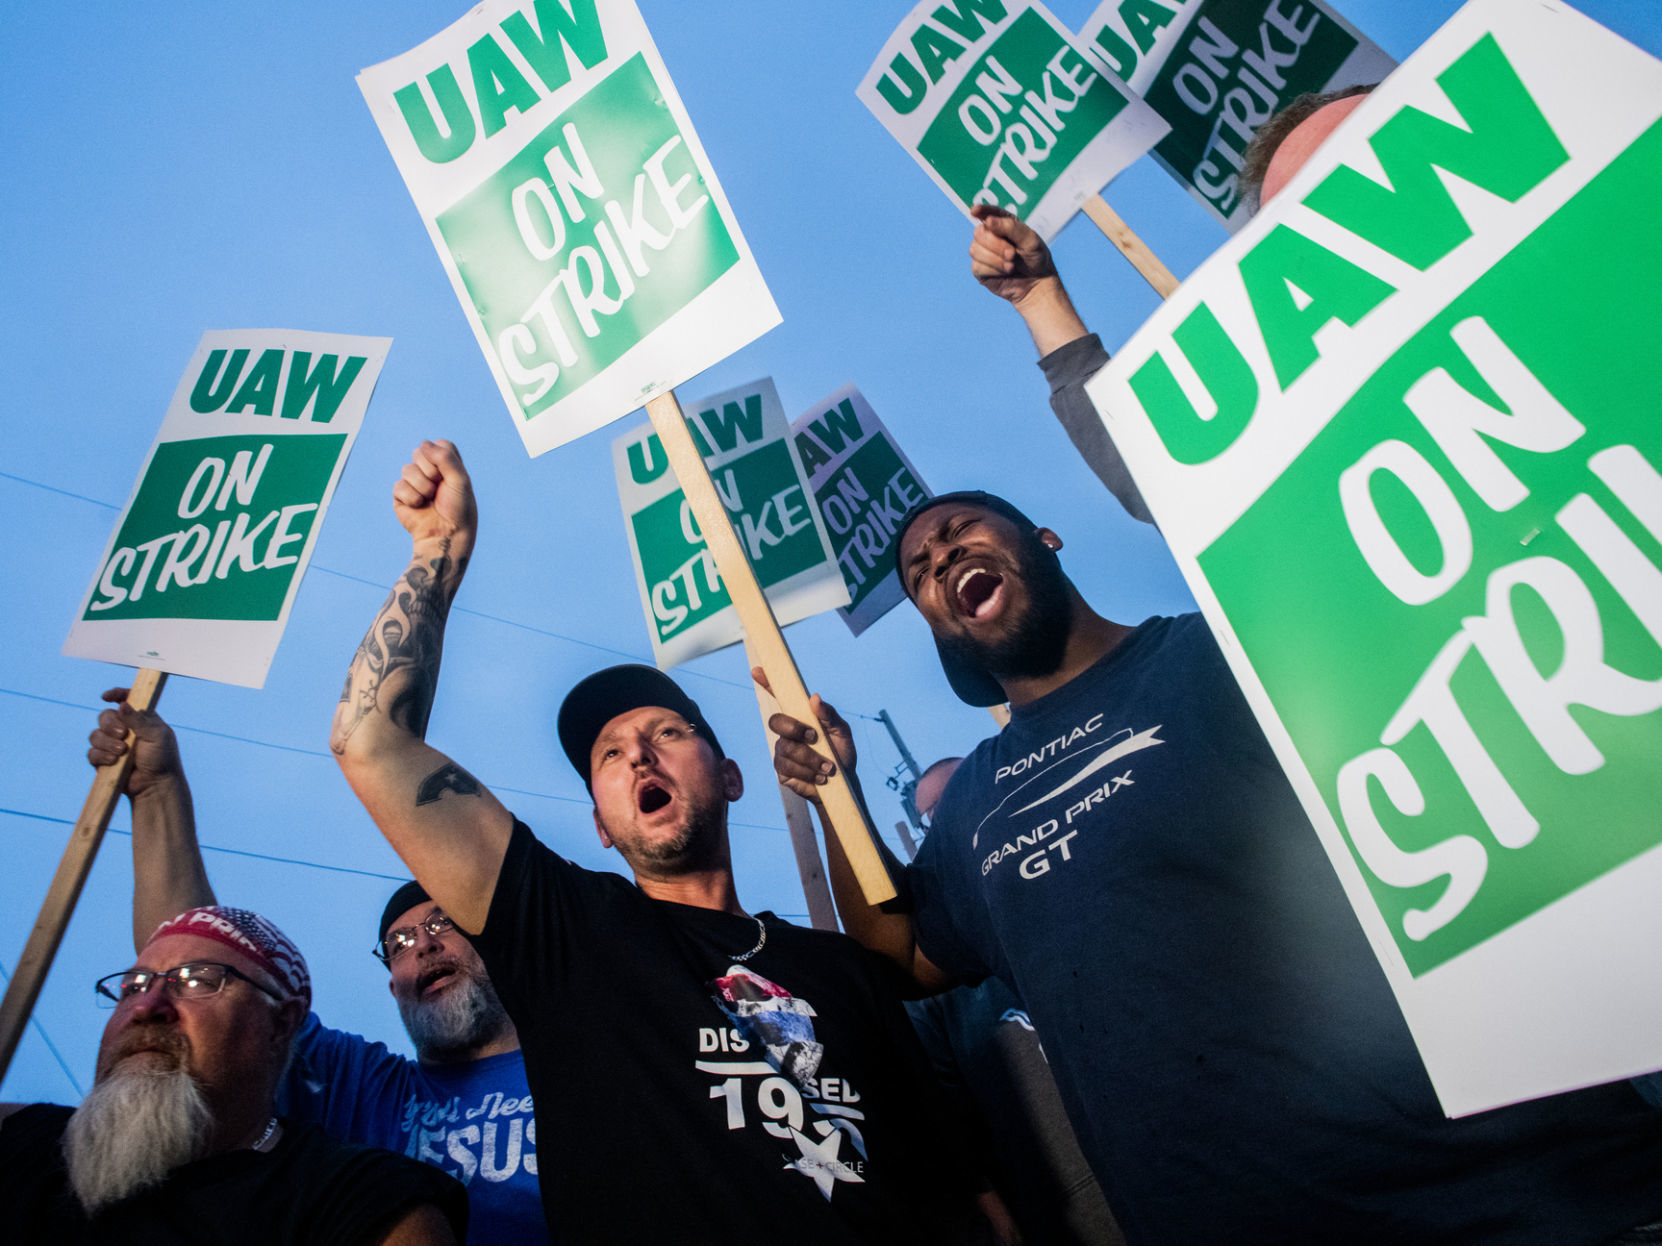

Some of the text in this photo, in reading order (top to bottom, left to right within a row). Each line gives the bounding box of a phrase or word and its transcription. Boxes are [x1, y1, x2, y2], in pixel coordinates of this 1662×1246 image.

[393, 0, 608, 164] UAW
[876, 0, 1008, 115] UAW
[1089, 0, 1186, 82] UA
[1172, 15, 1239, 115] ON
[957, 55, 1022, 146] ON
[1192, 0, 1320, 210] STRIKE
[511, 121, 604, 262] ON
[498, 134, 709, 407] STRIKE
[1127, 31, 1571, 466] UAW
[189, 348, 368, 423] UAW
[178, 443, 274, 519] ON
[822, 466, 870, 535] ON
[1338, 315, 1587, 605] ON
[90, 502, 318, 611] STRIKE
[1337, 444, 1662, 941] STRI
[995, 713, 1103, 784] PONTIAC
[981, 769, 1135, 876] GRAND PRIX
[1019, 829, 1078, 880] GT
